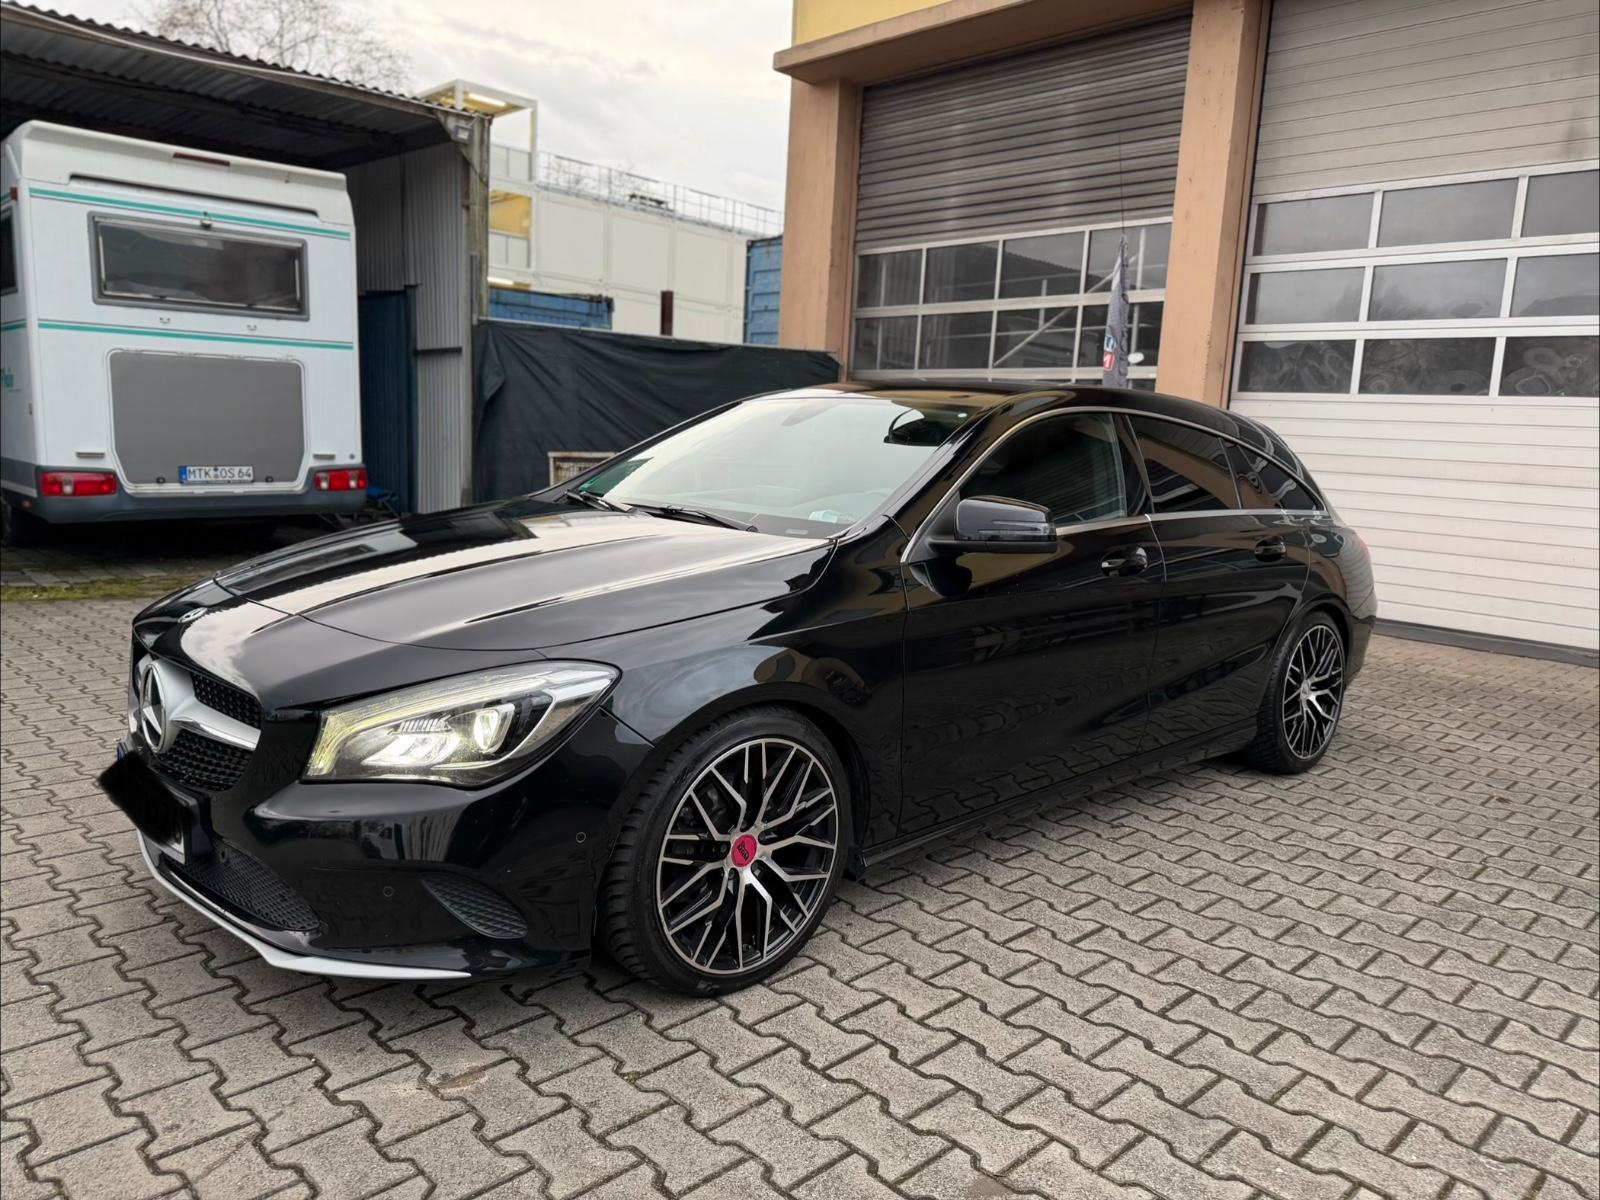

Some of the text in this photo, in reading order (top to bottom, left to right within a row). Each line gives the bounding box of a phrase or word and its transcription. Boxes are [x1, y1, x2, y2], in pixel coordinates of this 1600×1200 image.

[188, 468, 252, 479] MTK OS 64
